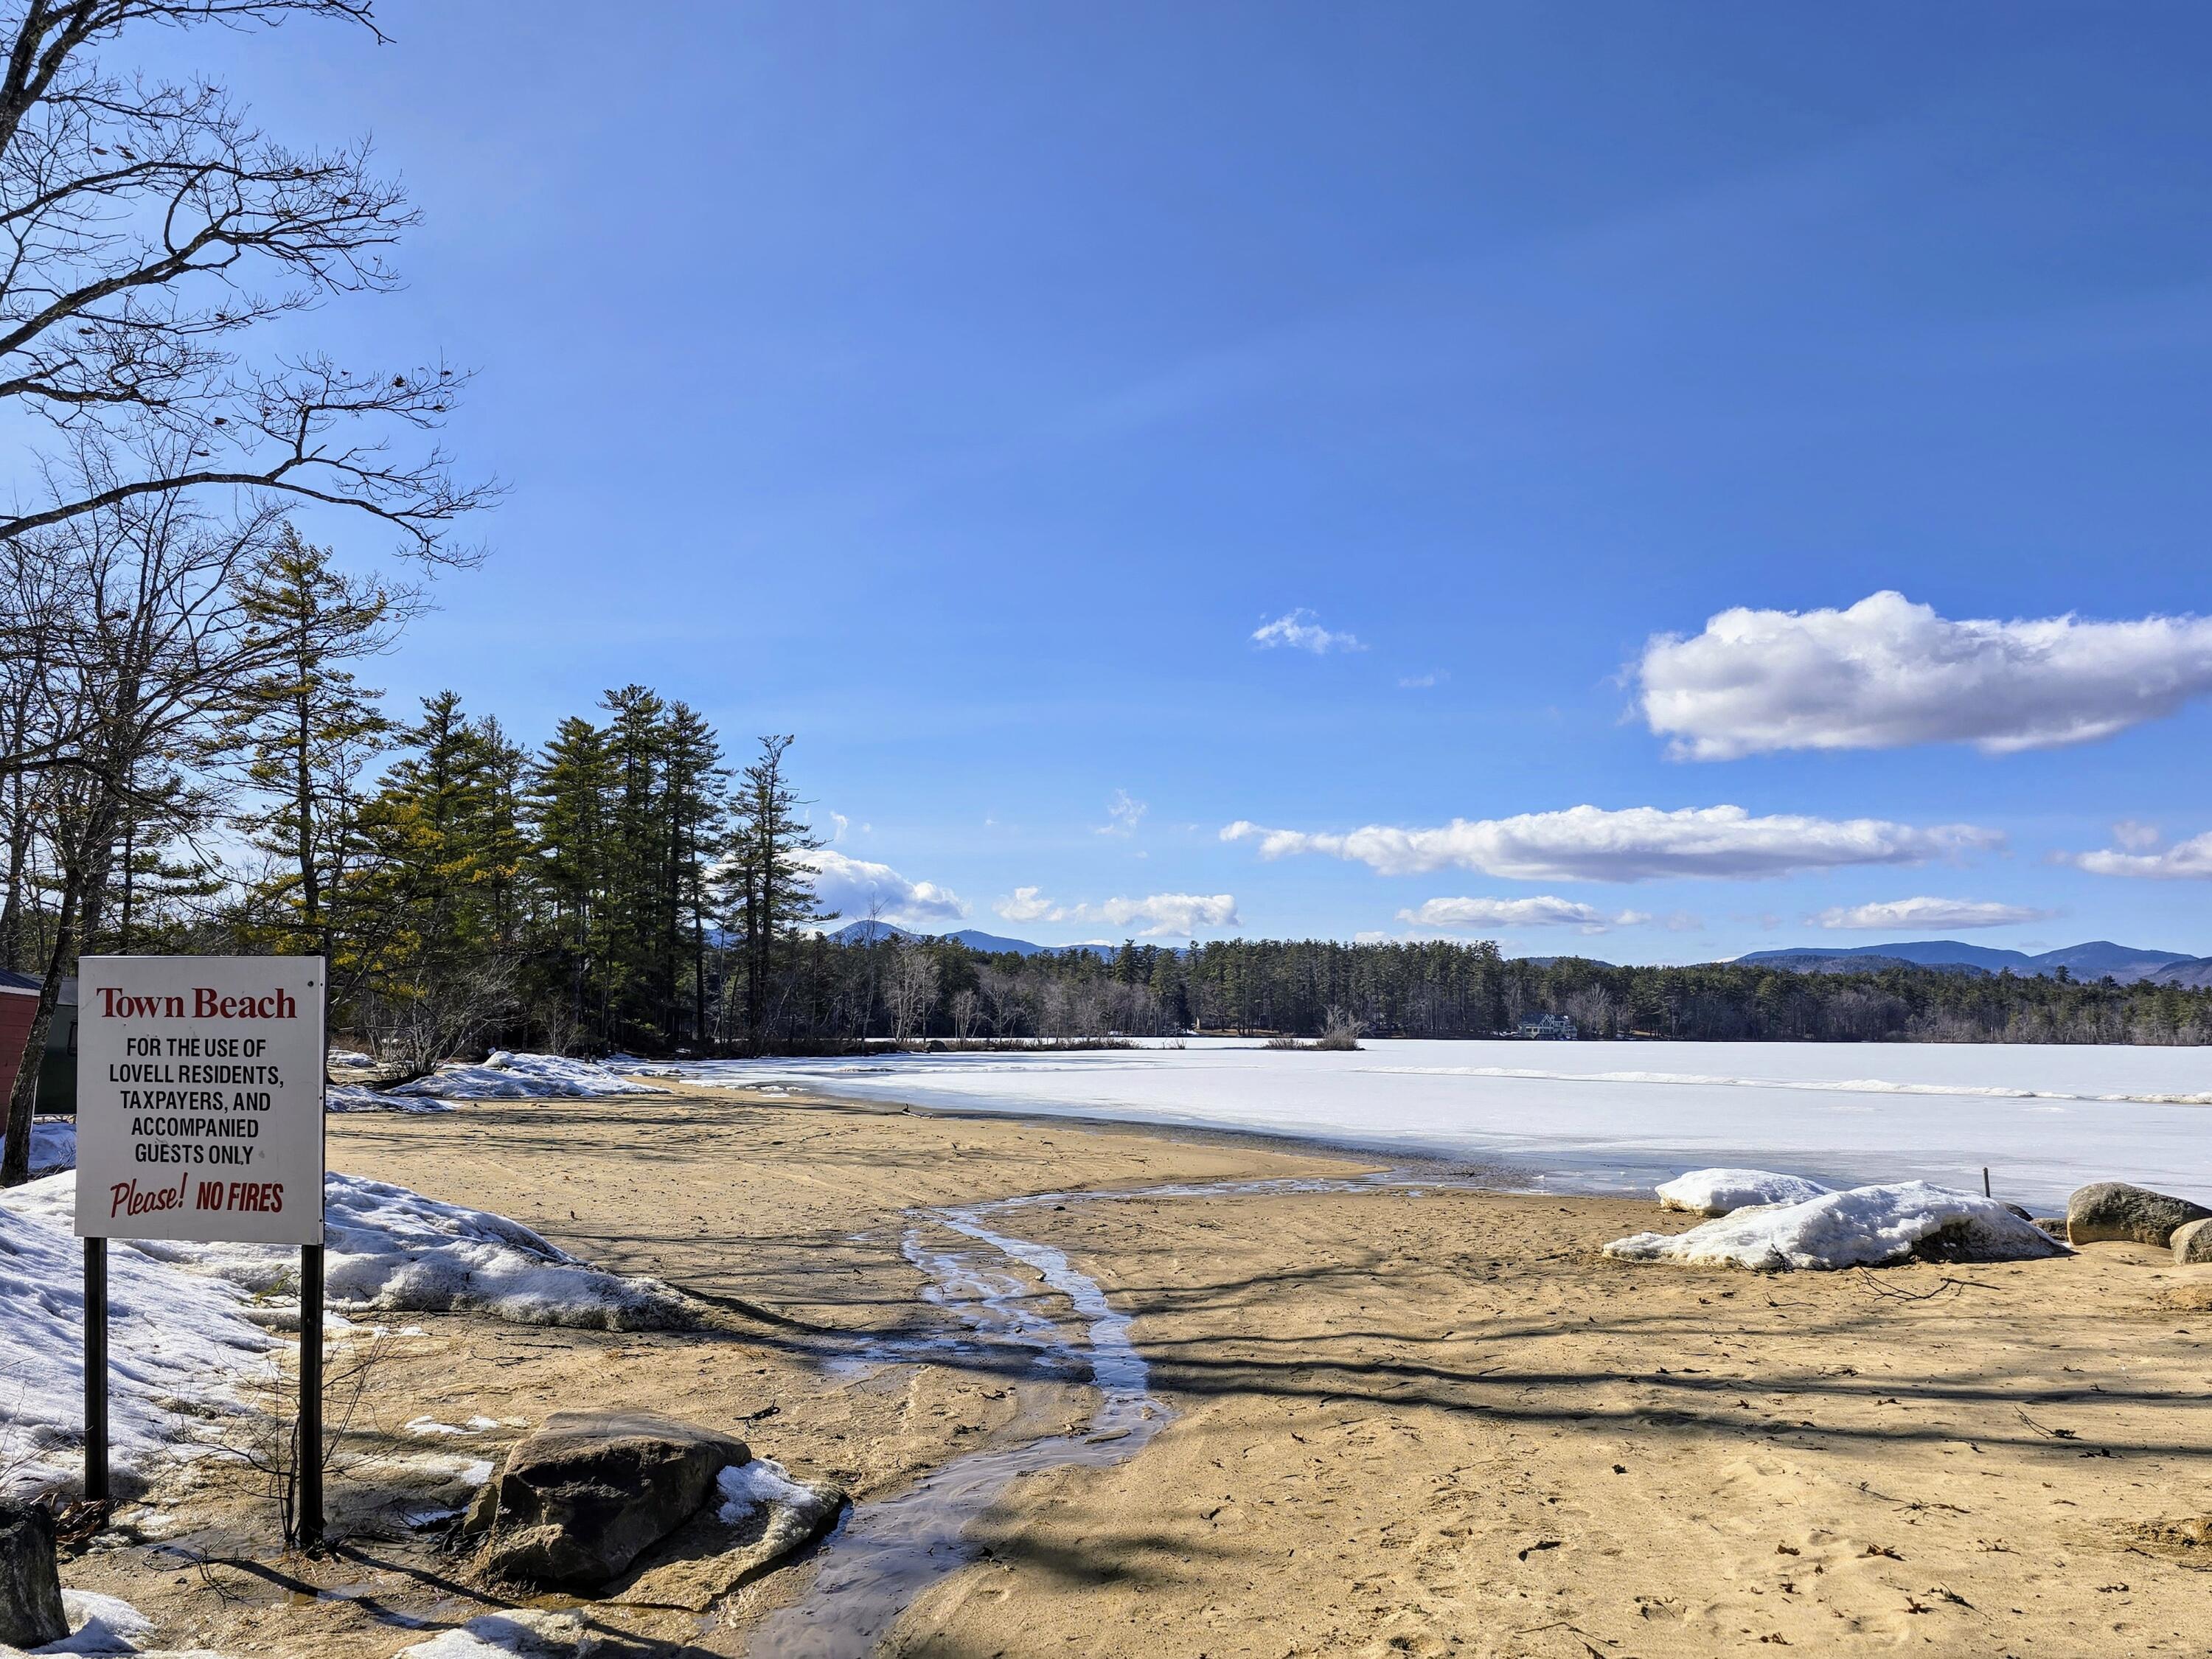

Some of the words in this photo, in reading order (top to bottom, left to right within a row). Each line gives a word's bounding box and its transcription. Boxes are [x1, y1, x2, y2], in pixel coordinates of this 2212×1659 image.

[97, 988, 186, 1018] Town
[192, 988, 297, 1018] Beach
[127, 1038, 161, 1057] FOR
[167, 1038, 200, 1057] THE
[205, 1039, 238, 1057] USE
[243, 1039, 266, 1057] OF
[110, 1065, 174, 1082] LOVELL
[179, 1065, 284, 1088] RESIDENTS,
[120, 1091, 228, 1113] TAXPAYERS,
[233, 1093, 271, 1111] AND
[131, 1118, 259, 1138] ACCOMPANIED
[135, 1144, 204, 1164] GUESTS
[209, 1146, 254, 1165] ONLY
[110, 1172, 188, 1218] Please!
[196, 1182, 223, 1210] NO
[227, 1183, 283, 1213] FIRES
